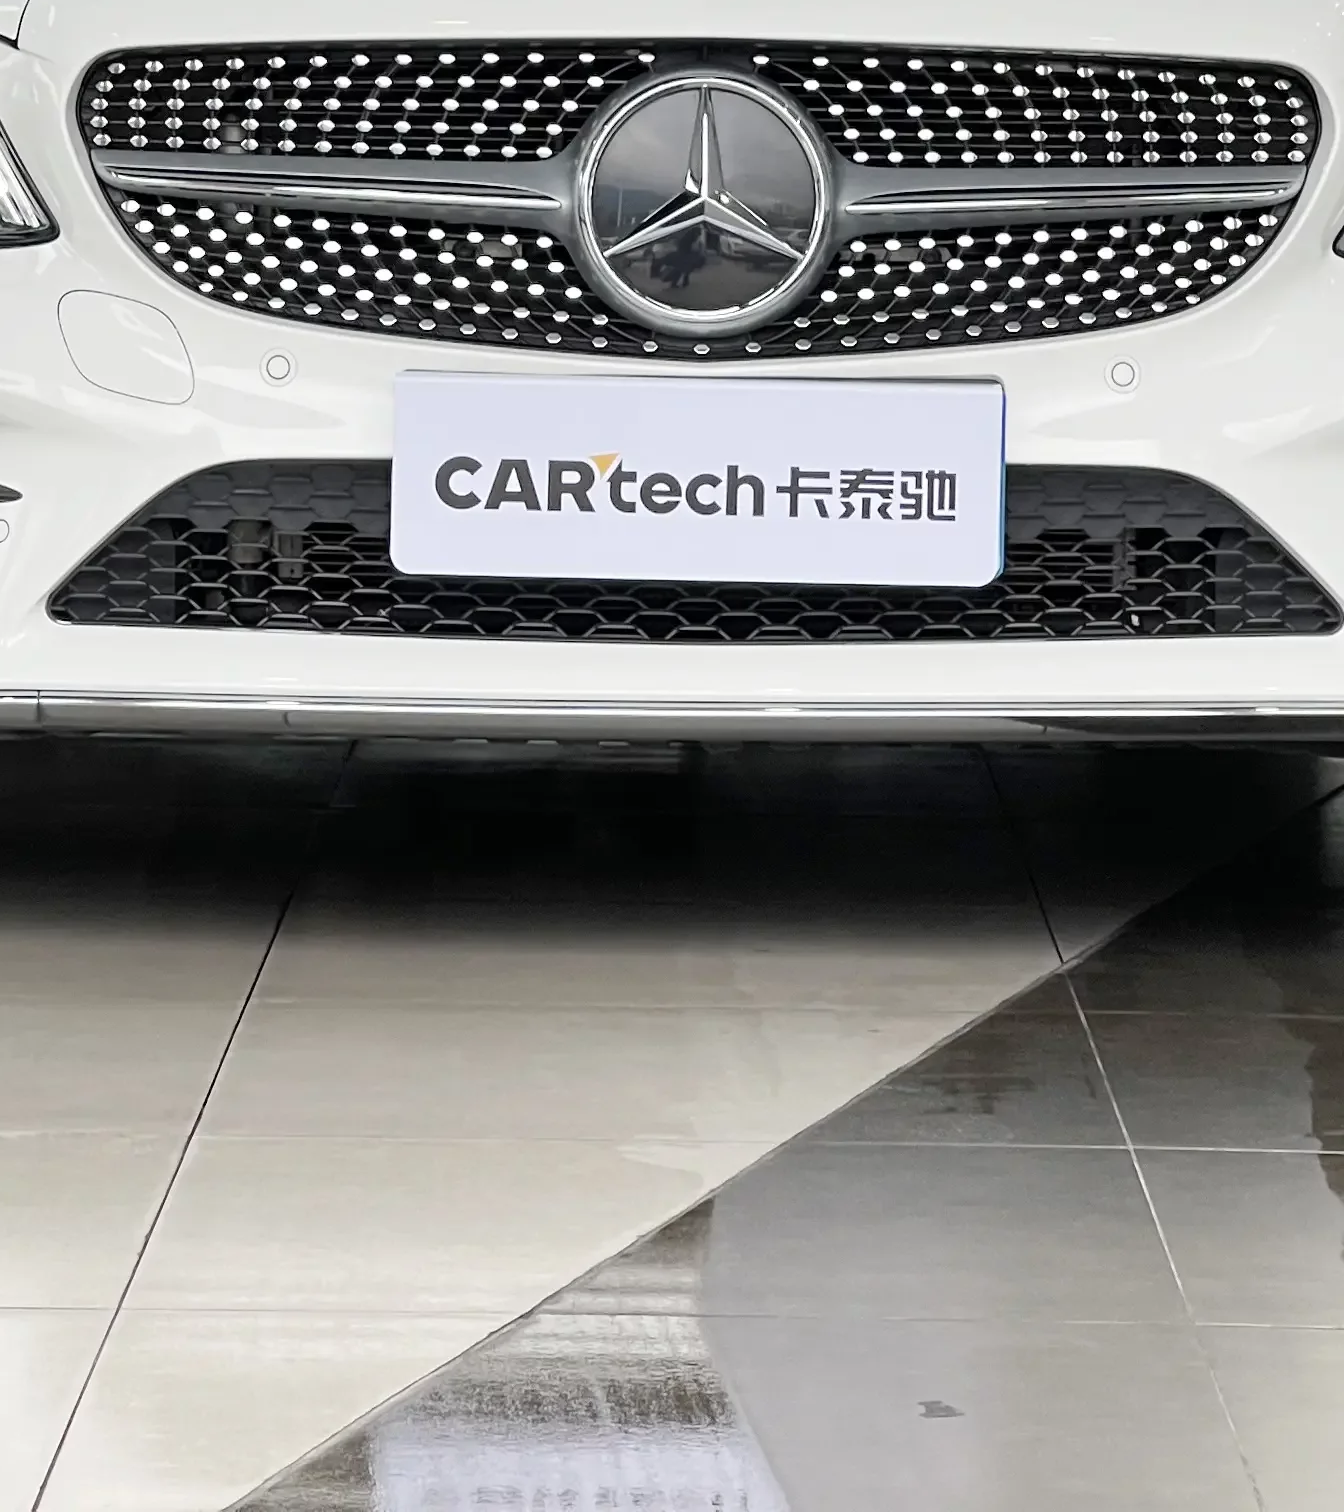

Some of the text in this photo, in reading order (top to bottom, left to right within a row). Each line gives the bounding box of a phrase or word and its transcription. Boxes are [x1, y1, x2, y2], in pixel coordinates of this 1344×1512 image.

[434, 452, 957, 522] CARtech 卡泰驰
